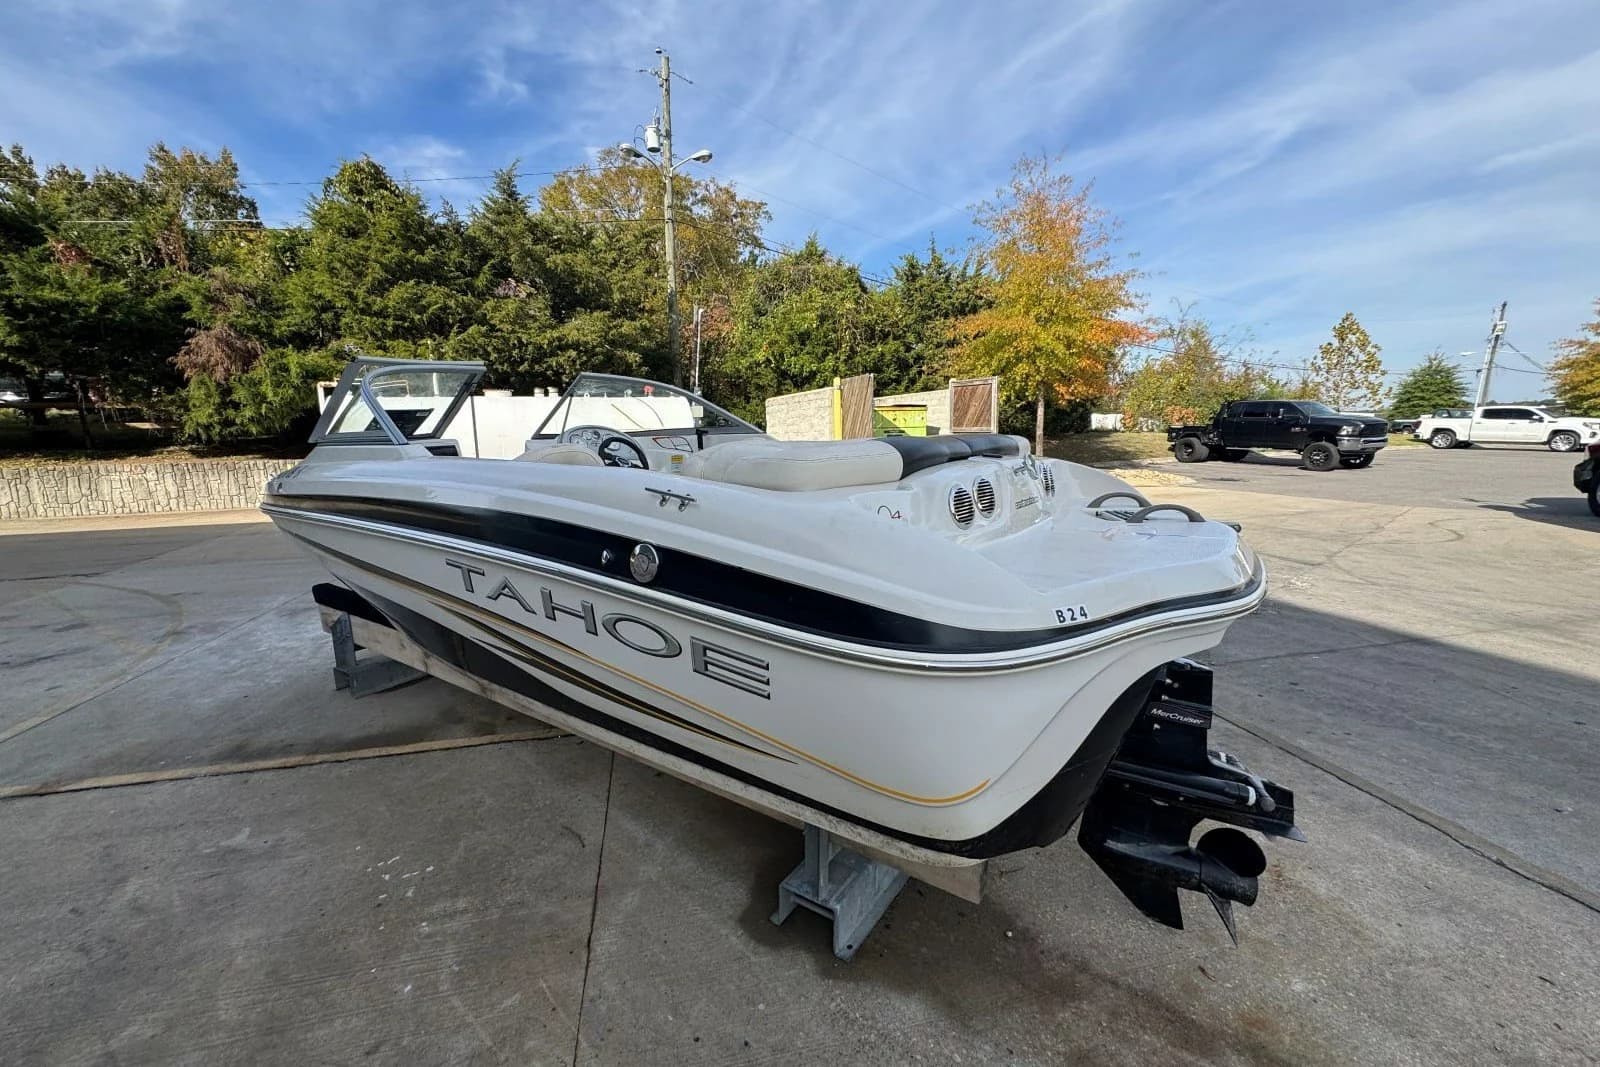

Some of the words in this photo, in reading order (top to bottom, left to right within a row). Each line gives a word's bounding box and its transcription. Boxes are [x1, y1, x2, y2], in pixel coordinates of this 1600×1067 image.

[1055, 605, 1088, 624] B24
[445, 558, 770, 700] TAHOE
[1150, 708, 1205, 725] MerCruiser
